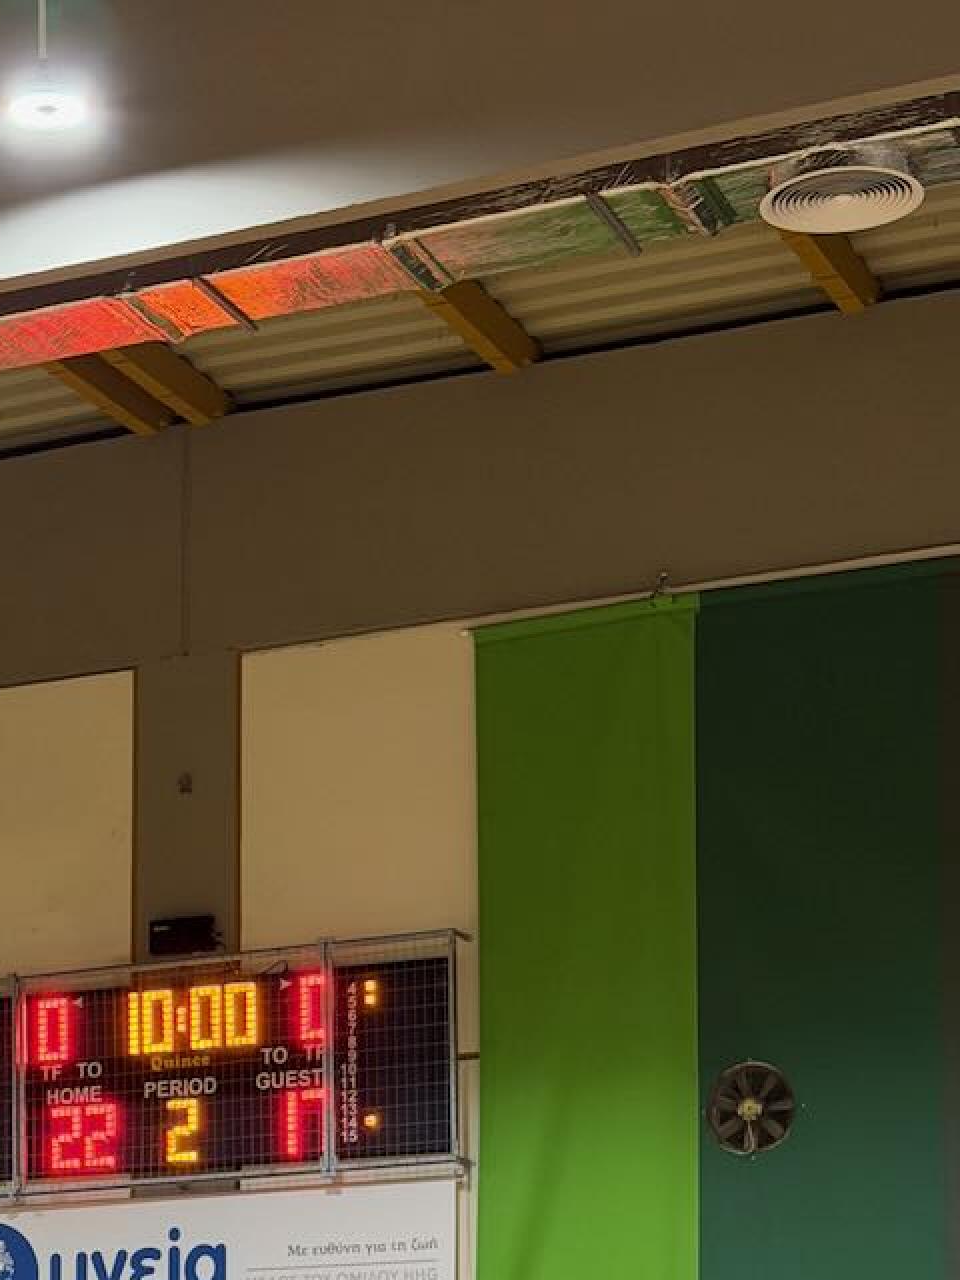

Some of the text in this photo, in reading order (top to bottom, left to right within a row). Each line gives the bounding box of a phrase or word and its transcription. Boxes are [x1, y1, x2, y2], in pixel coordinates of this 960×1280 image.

[38, 998, 69, 1060] 0
[128, 982, 257, 1056] 10:00
[260, 1046, 289, 1065] TO
[41, 1061, 103, 1081] TF TO
[255, 1067, 326, 1091] GUEST
[47, 1086, 103, 1105] HOME
[144, 1076, 217, 1099] PERIOD
[50, 1104, 117, 1169] 22
[166, 1097, 199, 1163] 2
